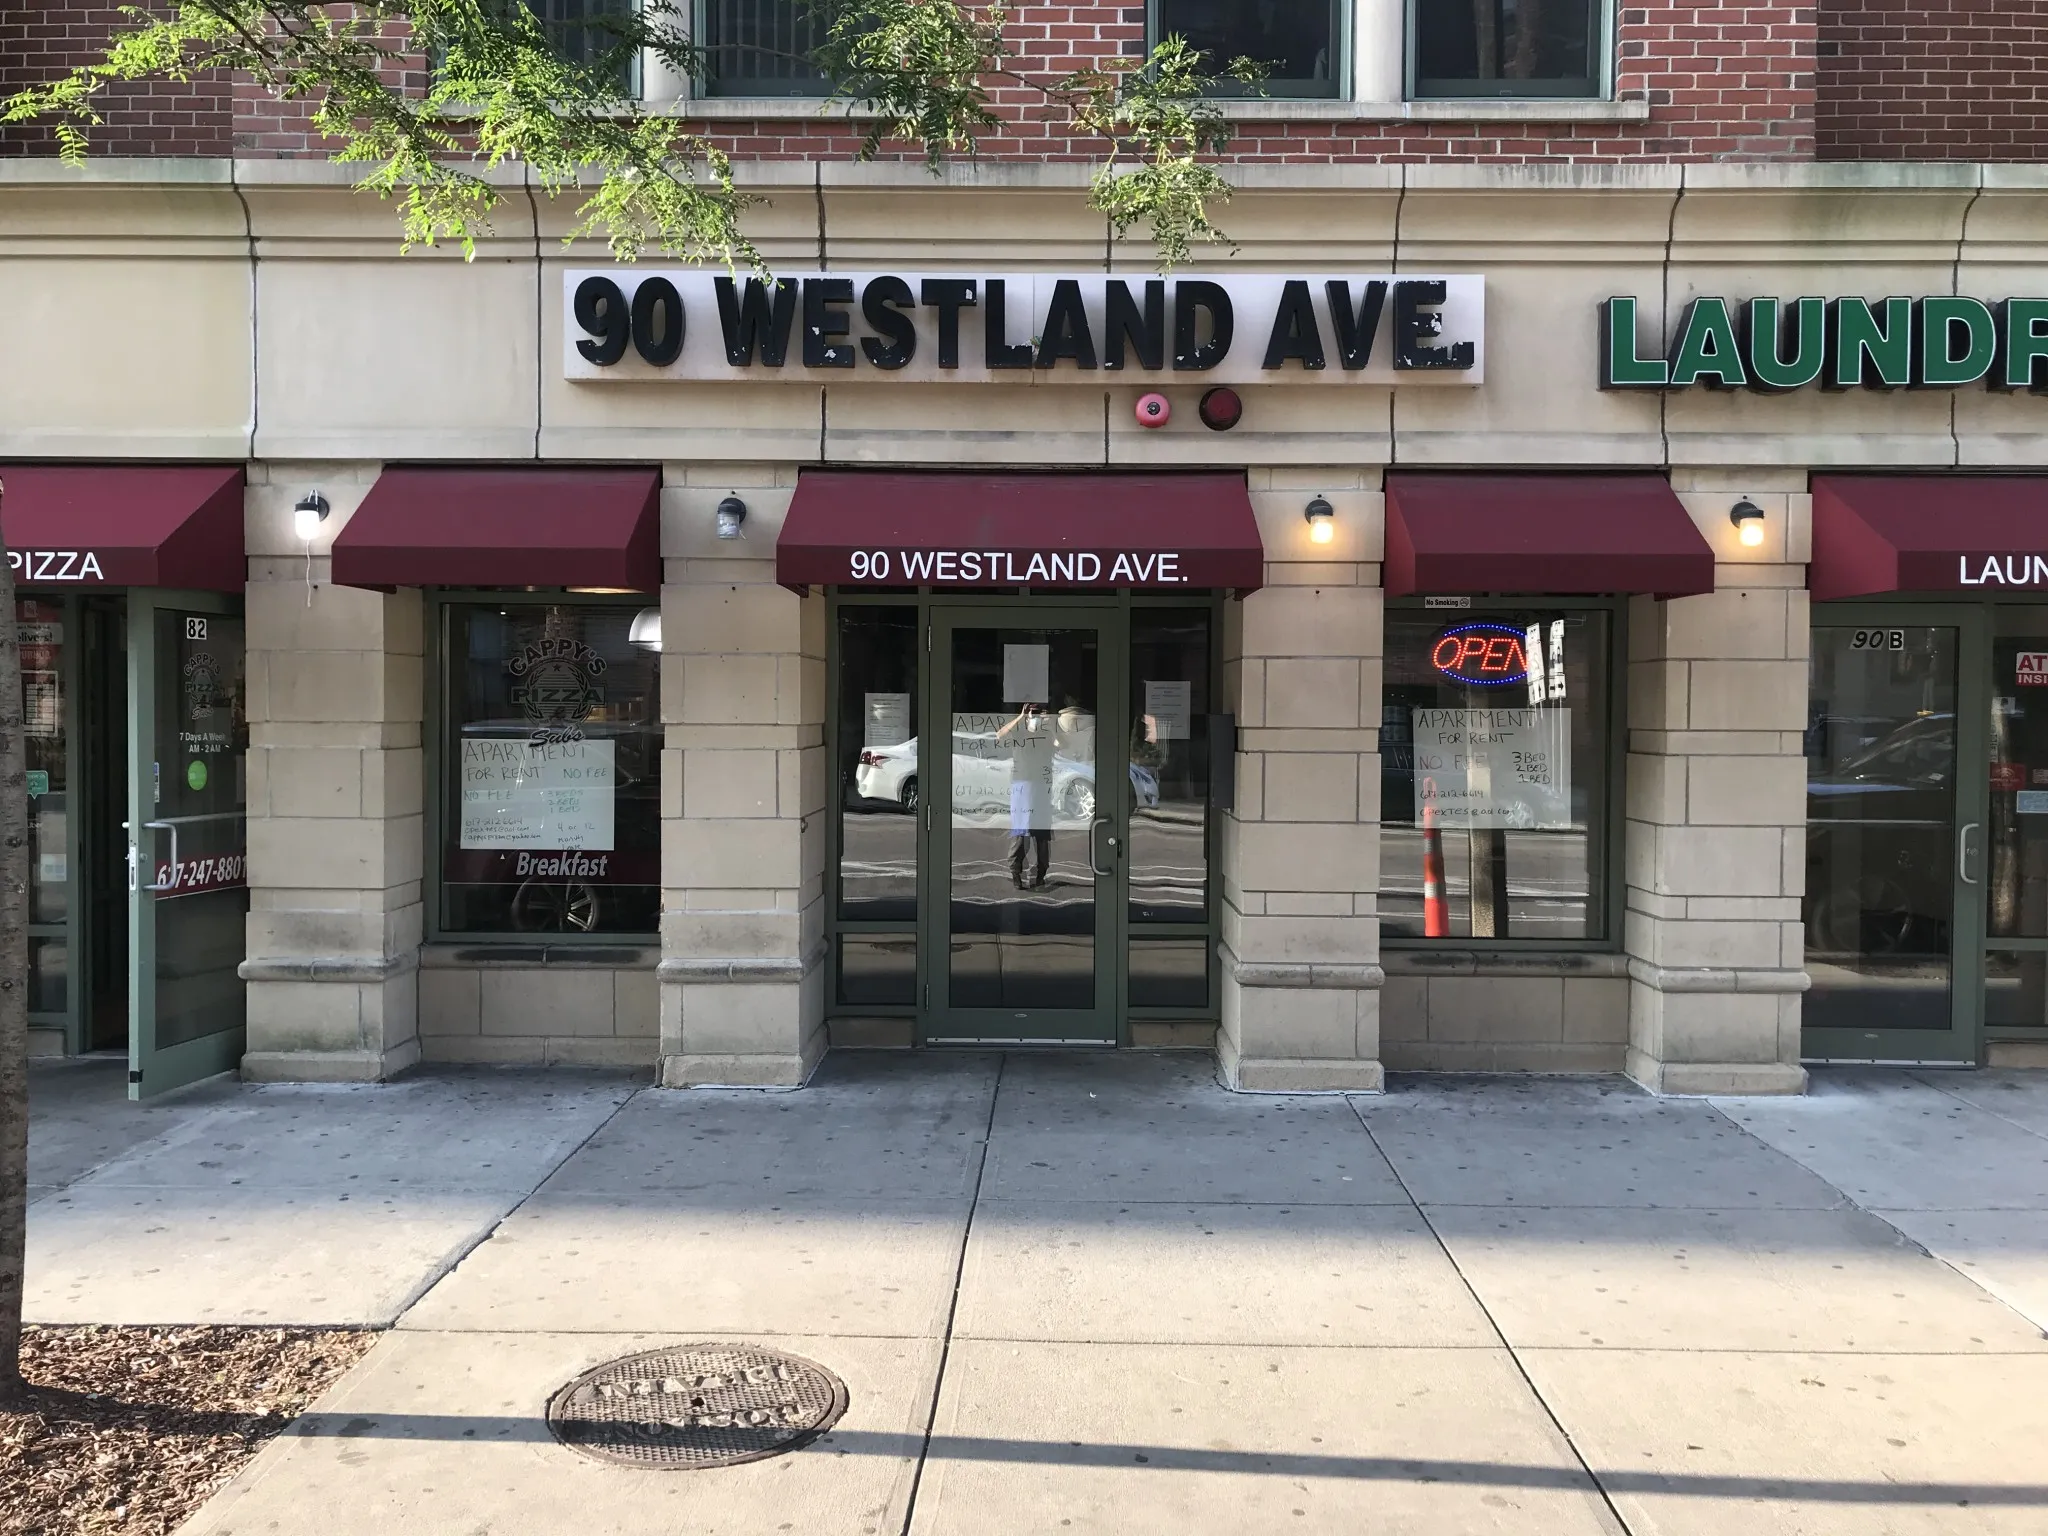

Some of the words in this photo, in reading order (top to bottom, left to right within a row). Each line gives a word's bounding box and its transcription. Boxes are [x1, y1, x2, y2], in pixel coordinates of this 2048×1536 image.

[574, 276, 686, 367] 90
[714, 276, 1235, 370] WESTLAND
[6, 552, 104, 580] PIZZA
[850, 551, 890, 580] 90
[901, 551, 1100, 580] WESTLAND
[1109, 553, 1189, 582] AVE.
[1426, 598, 1434, 606] No
[1435, 598, 1459, 608] Smoking
[187, 619, 206, 639] 82
[1853, 630, 1884, 649] 90
[1889, 631, 1903, 649] B
[508, 638, 608, 677] CAPPY'S
[1432, 637, 1528, 671] OPEN
[512, 688, 601, 703] PIZZA
[1418, 709, 1536, 728] APARTMENT
[185, 732, 201, 743] Days
[202, 732, 208, 741] A
[529, 726, 585, 748] Subs
[961, 738, 988, 751] FOR
[994, 737, 1046, 749] RENT
[1438, 732, 1461, 744] FOR
[1469, 732, 1514, 744] RENT
[464, 741, 590, 764] APARTMENT
[1420, 755, 1443, 770] NO
[1454, 754, 1488, 770] FEE
[1512, 752, 1523, 764] 3
[466, 768, 494, 782] FOR
[501, 766, 545, 779] RENT
[563, 768, 582, 779] NO
[586, 767, 608, 779] FEE
[1527, 763, 1548, 773] BED
[1529, 774, 1551, 784] BED
[157, 856, 247, 889] 67-247-8801
[516, 852, 608, 876] Breakfast
